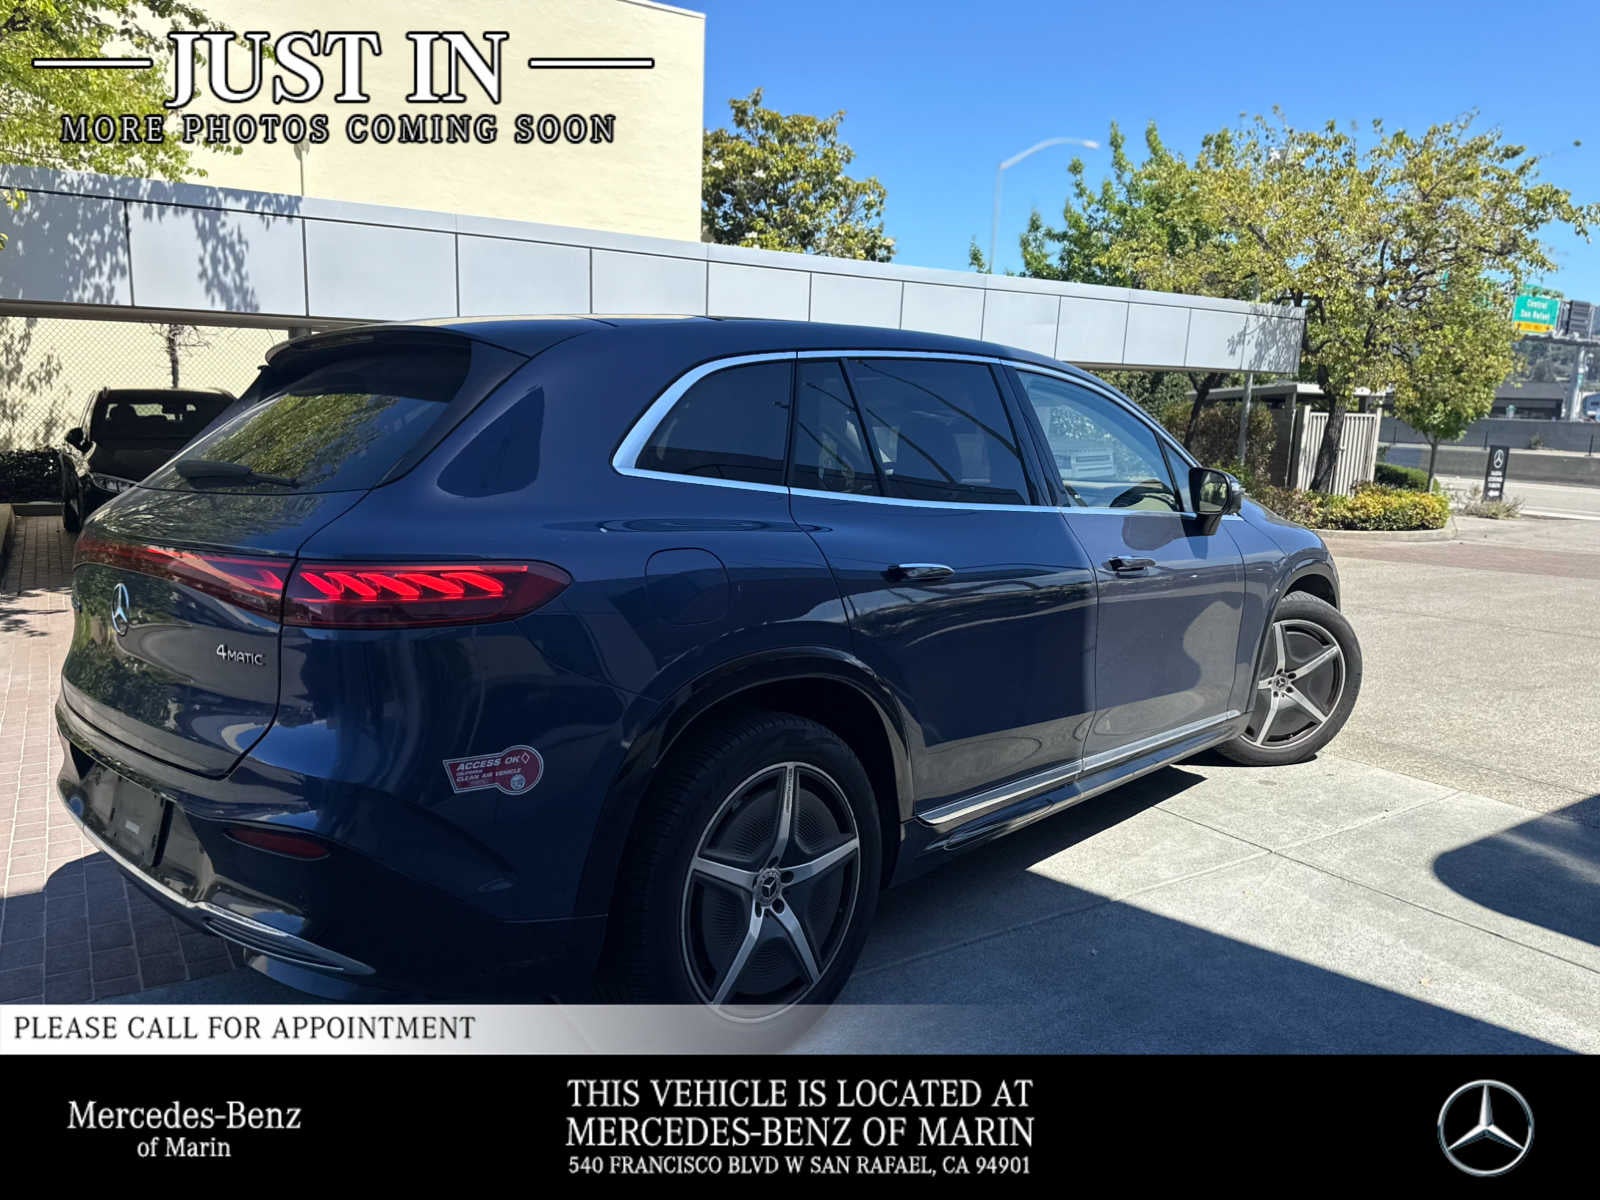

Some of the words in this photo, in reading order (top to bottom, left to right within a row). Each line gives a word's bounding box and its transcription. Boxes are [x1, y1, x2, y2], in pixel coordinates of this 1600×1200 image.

[216, 644, 263, 666] 4MATIC
[456, 758, 501, 771] ACCESS
[504, 755, 520, 764] OK
